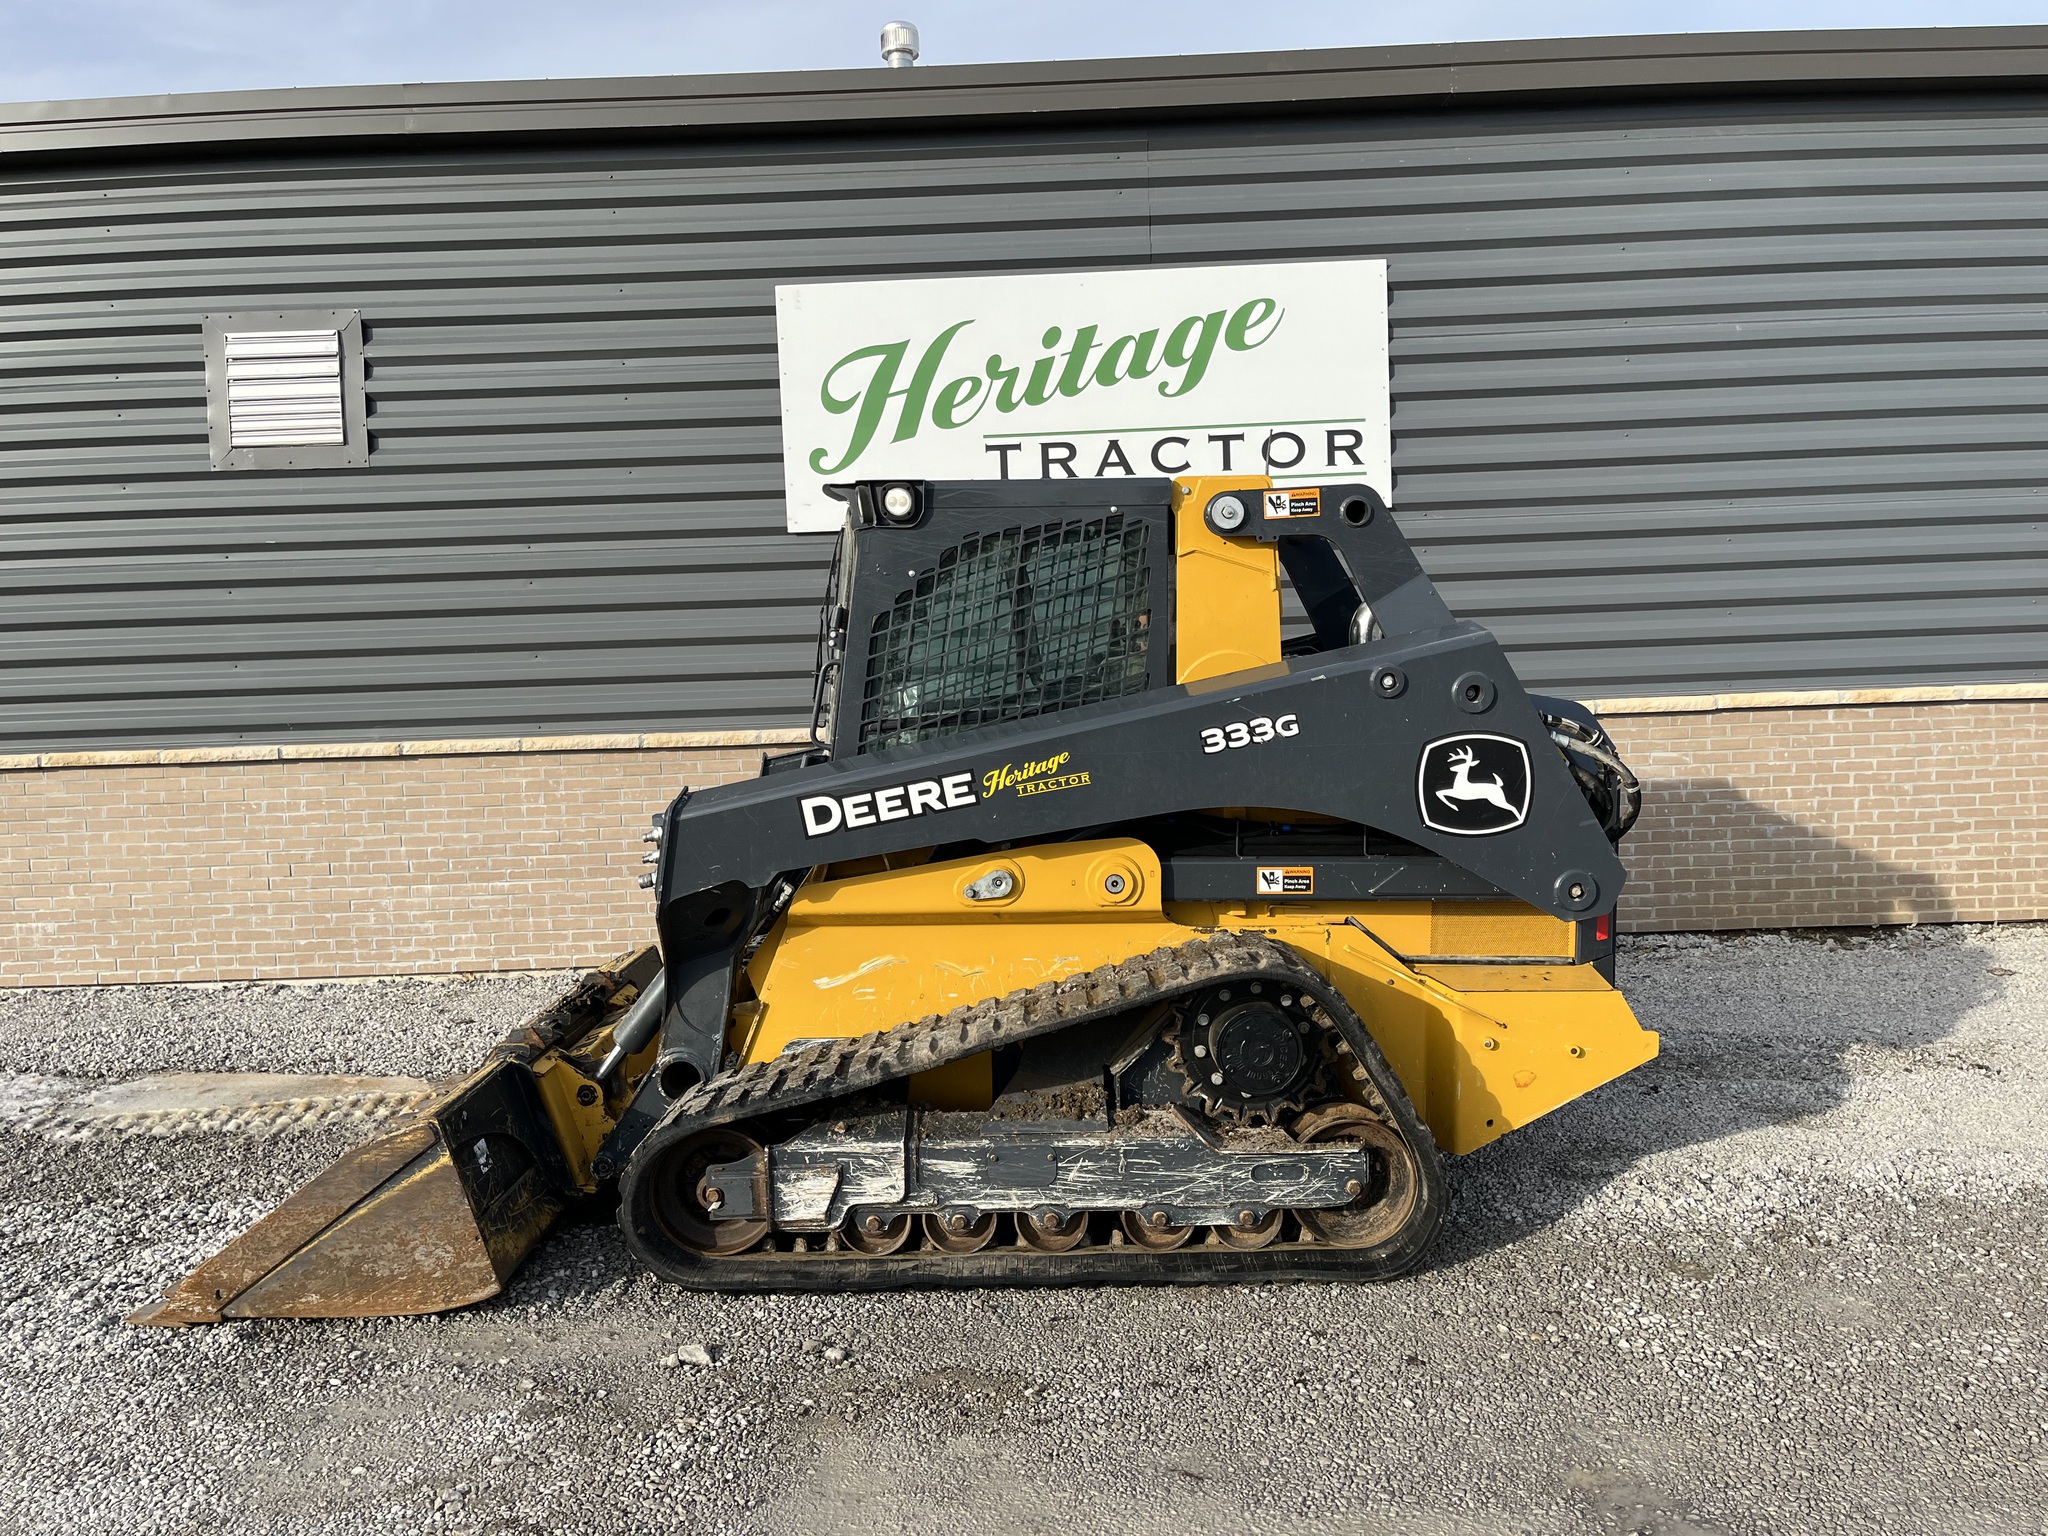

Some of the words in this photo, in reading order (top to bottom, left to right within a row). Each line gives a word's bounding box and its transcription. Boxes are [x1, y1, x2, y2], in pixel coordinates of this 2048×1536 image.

[809, 297, 1285, 475] Heritage
[985, 428, 1365, 480] TRACTOR
[1200, 714, 1301, 754] 333G
[982, 751, 1071, 799] Heritage
[1016, 774, 1091, 795] TRACTOR
[800, 771, 977, 838] DEERE
